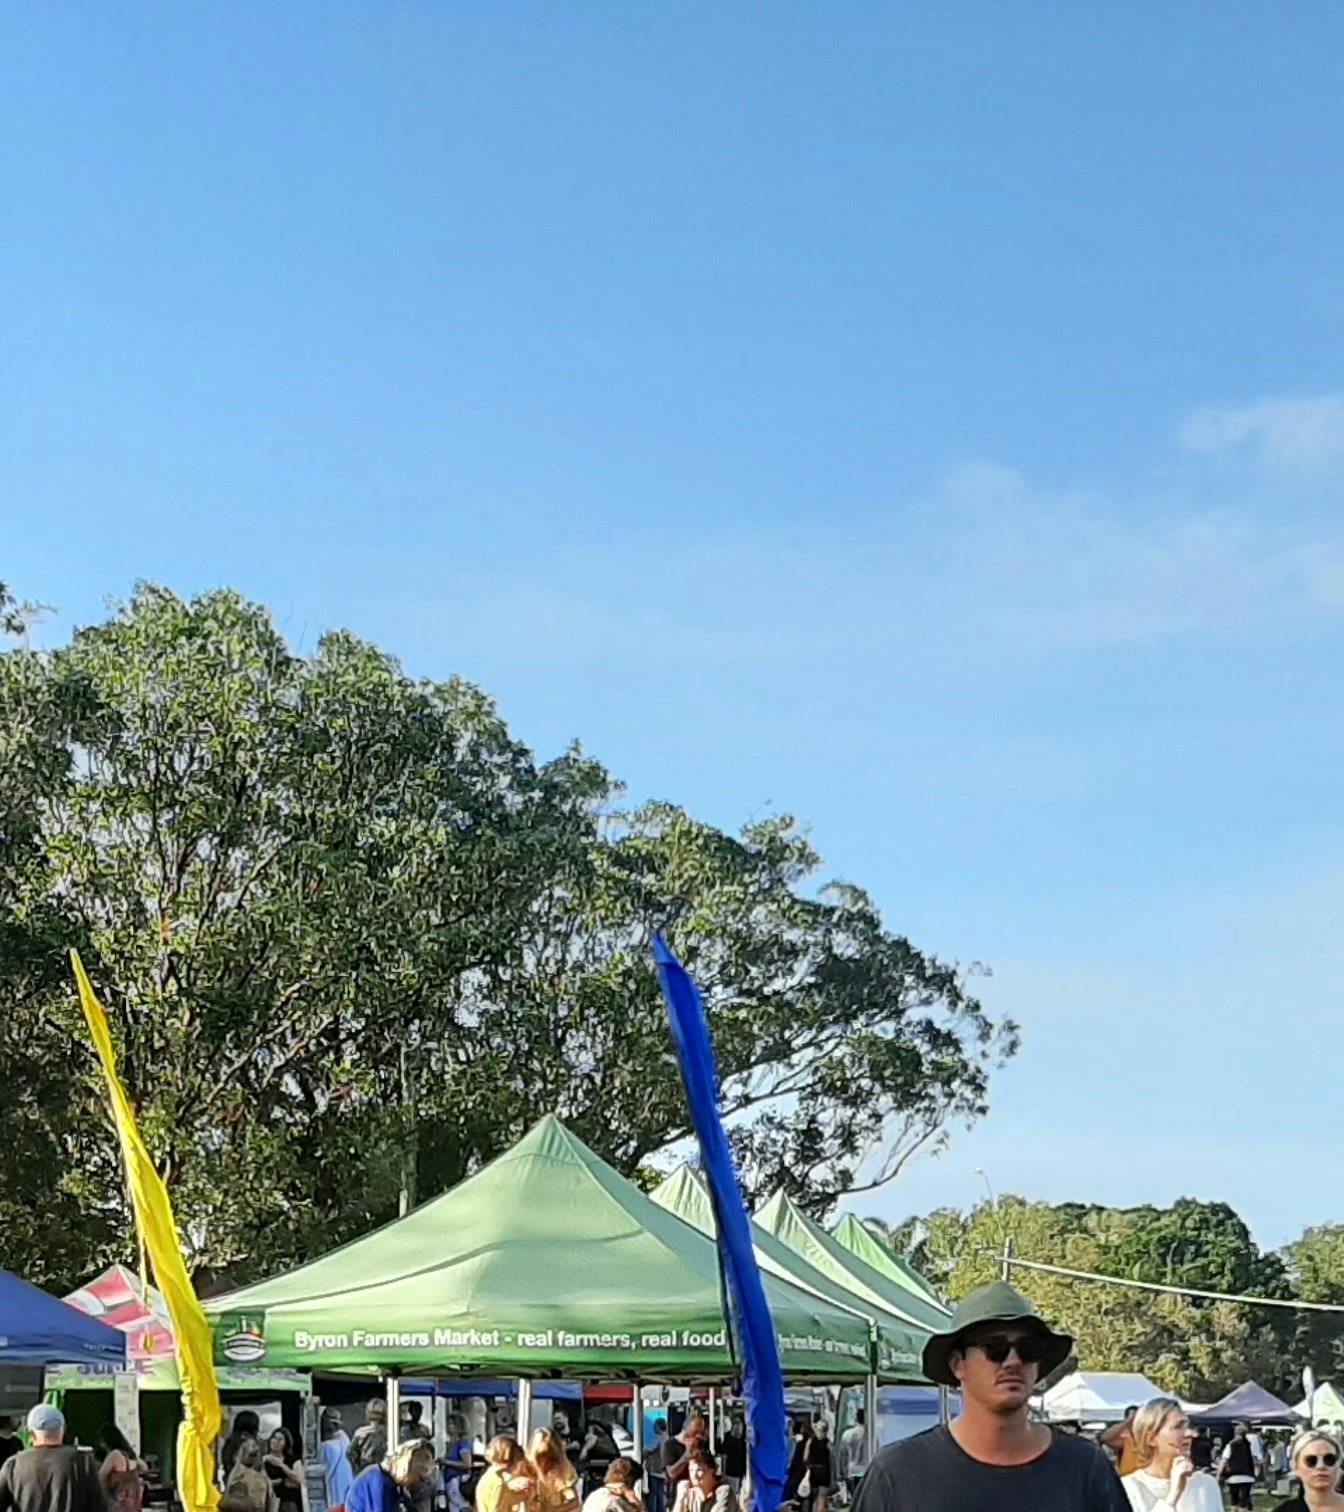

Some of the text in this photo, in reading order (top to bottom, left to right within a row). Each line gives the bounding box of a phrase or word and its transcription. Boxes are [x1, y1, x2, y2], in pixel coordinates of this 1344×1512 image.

[294, 1330, 349, 1351] Byron
[352, 1330, 429, 1348] Farmers
[434, 1327, 500, 1347] Market
[517, 1330, 553, 1347] real
[557, 1330, 637, 1350] farmers,
[641, 1330, 677, 1347] real
[681, 1329, 726, 1347] food
